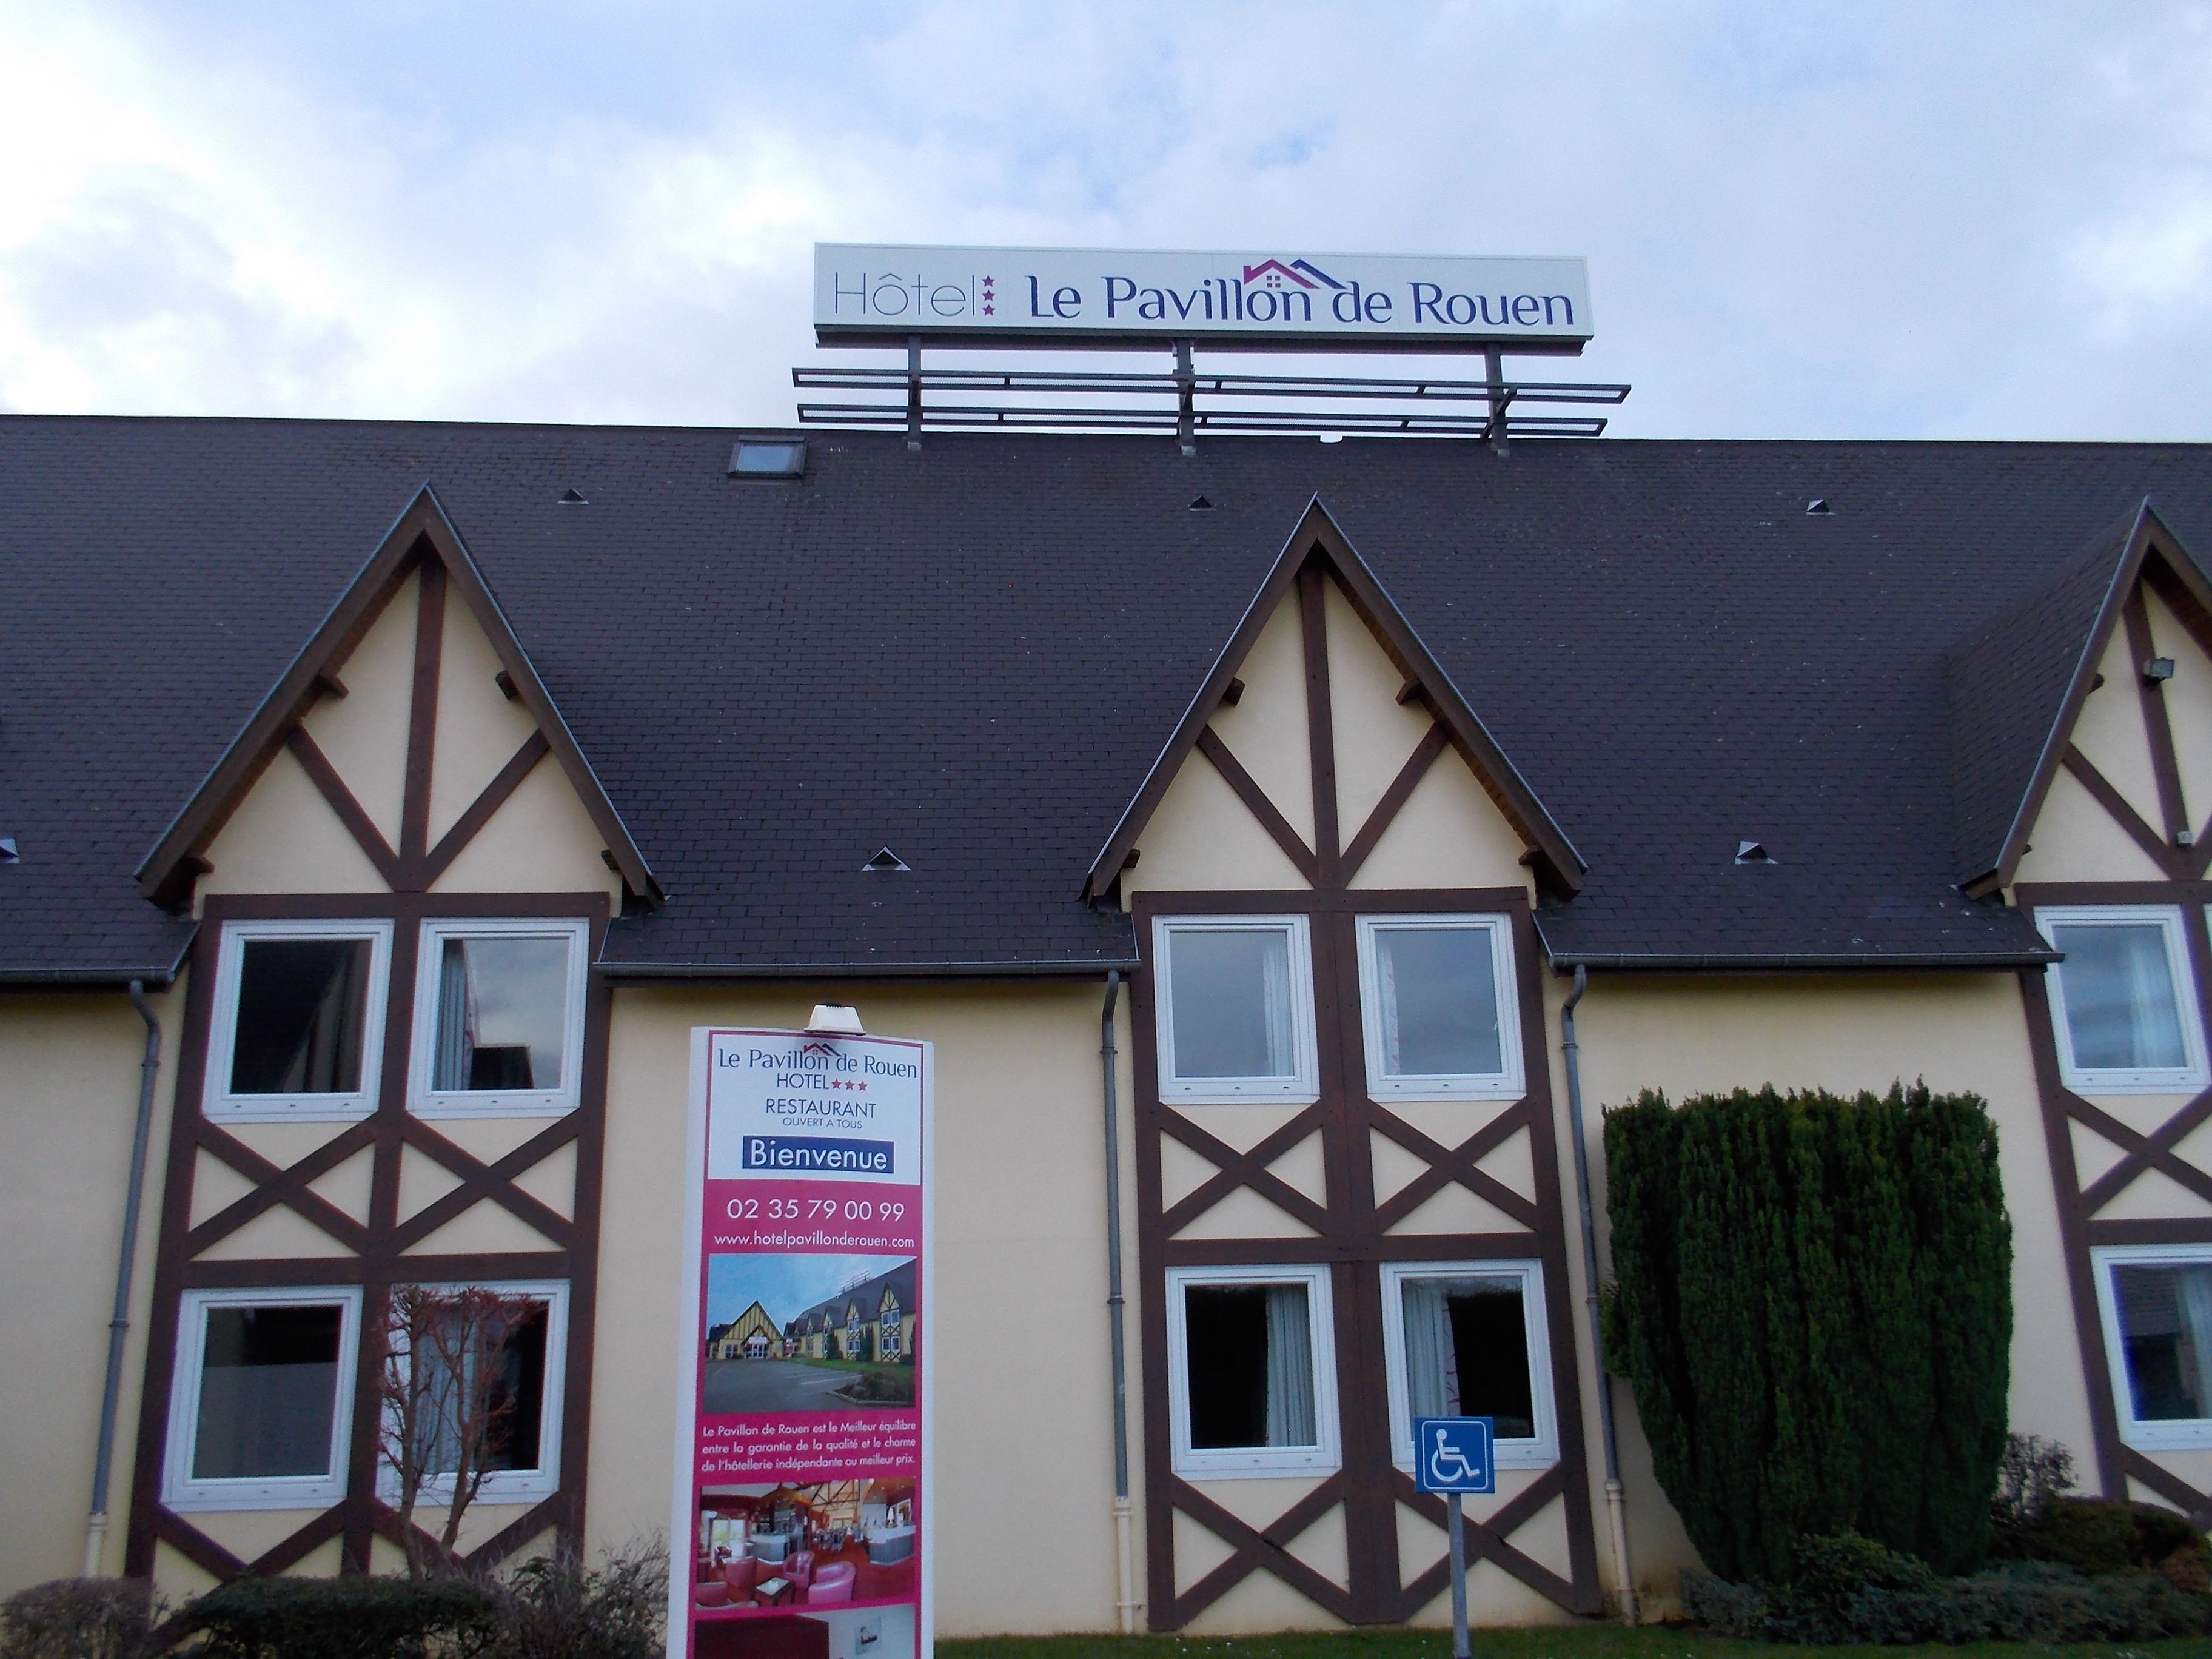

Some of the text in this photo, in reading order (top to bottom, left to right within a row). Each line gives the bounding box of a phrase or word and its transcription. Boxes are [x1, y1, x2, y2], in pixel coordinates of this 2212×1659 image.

[835, 272, 1574, 326] Hôtel Le Pavillon de Rouen
[719, 1049, 917, 1078] Le Pavillon de Rouen
[777, 1073, 829, 1090] HOTEL
[766, 1099, 876, 1118] RESTAURANT
[783, 1118, 823, 1127] OUVERT
[837, 1119, 862, 1128] TOUS
[750, 1139, 887, 1170] Bienvenue
[728, 1199, 905, 1221] 02 35 79 00 99
[714, 1230, 914, 1248] www.hotelpavillonderouen.com
[703, 1419, 916, 1437] Le Pavillon de Rouen est le Meilleur équilibre
[703, 1436, 916, 1455] entre la garantie de la qualité et le charme
[702, 1460, 715, 1472] de
[719, 1458, 773, 1470] l'hôtellerie
[776, 1457, 842, 1470] indépendante
[860, 1455, 893, 1466] meilleur
[896, 1455, 915, 1466] prix.
